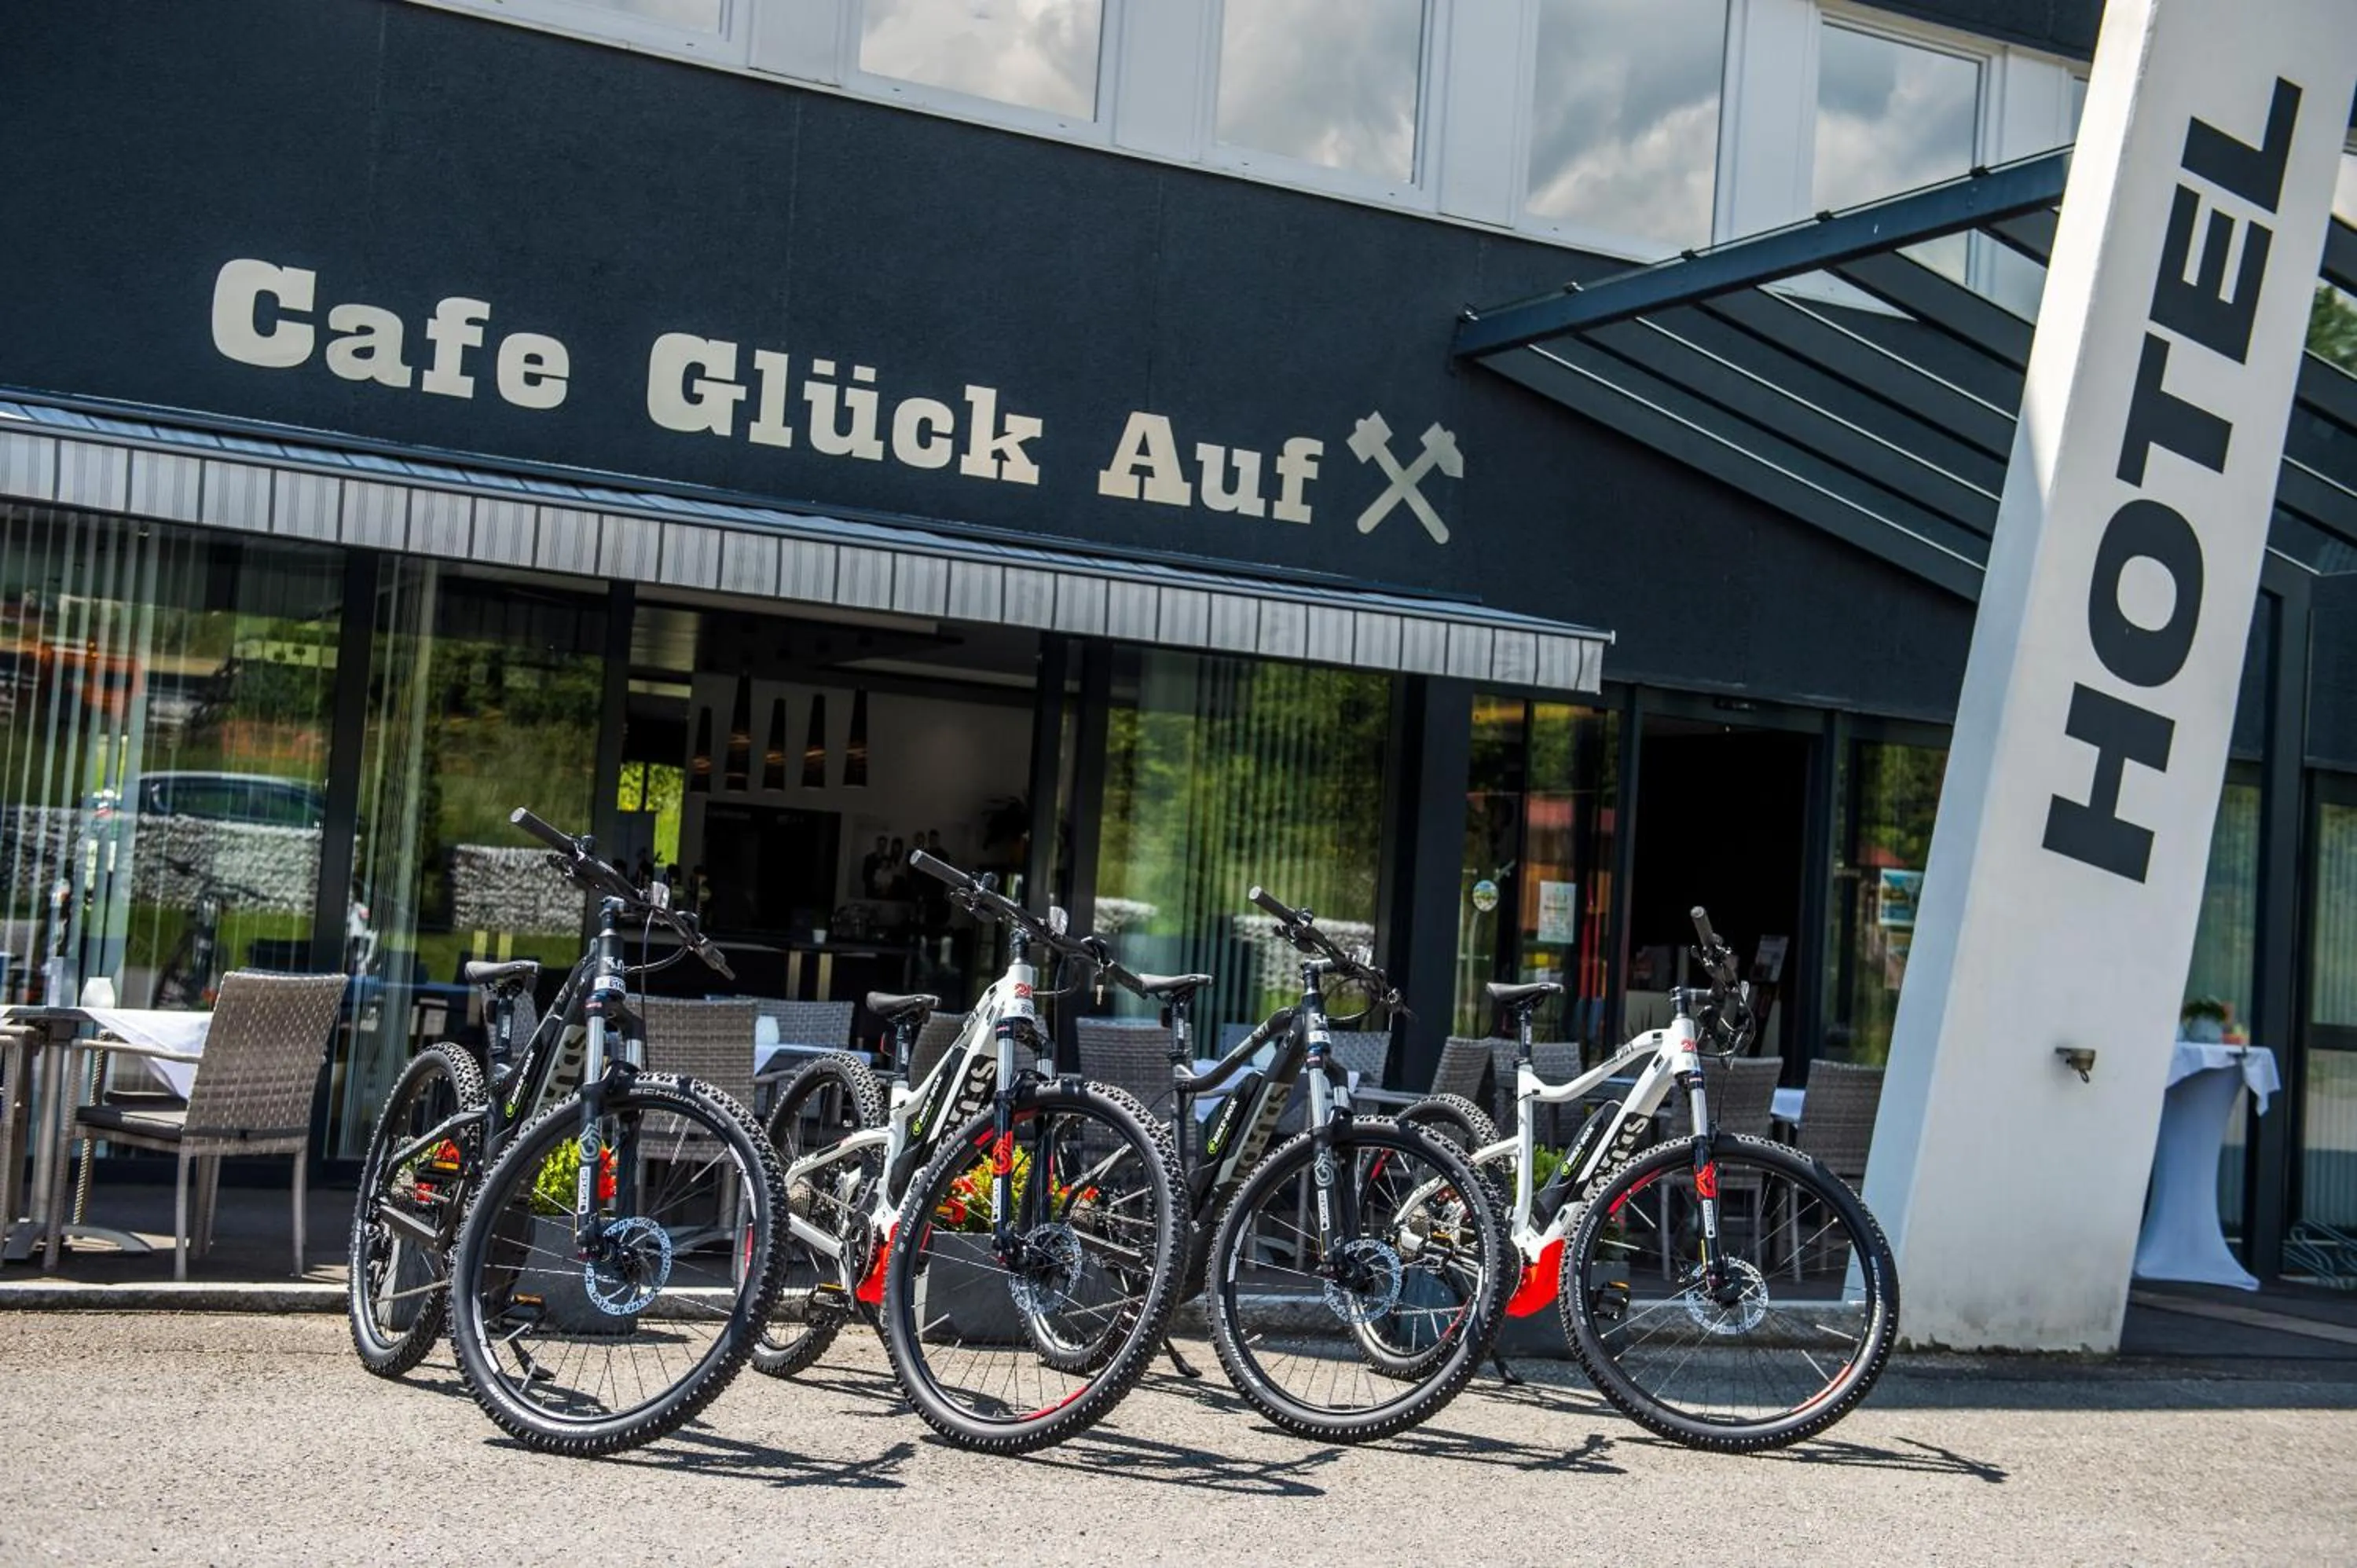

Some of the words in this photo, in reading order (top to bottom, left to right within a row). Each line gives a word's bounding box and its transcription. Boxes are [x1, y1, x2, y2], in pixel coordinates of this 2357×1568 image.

[212, 258, 570, 409] Cafe
[647, 332, 1043, 485] Glück
[1098, 411, 1324, 525] Auf
[2042, 76, 2302, 883] HOTEL
